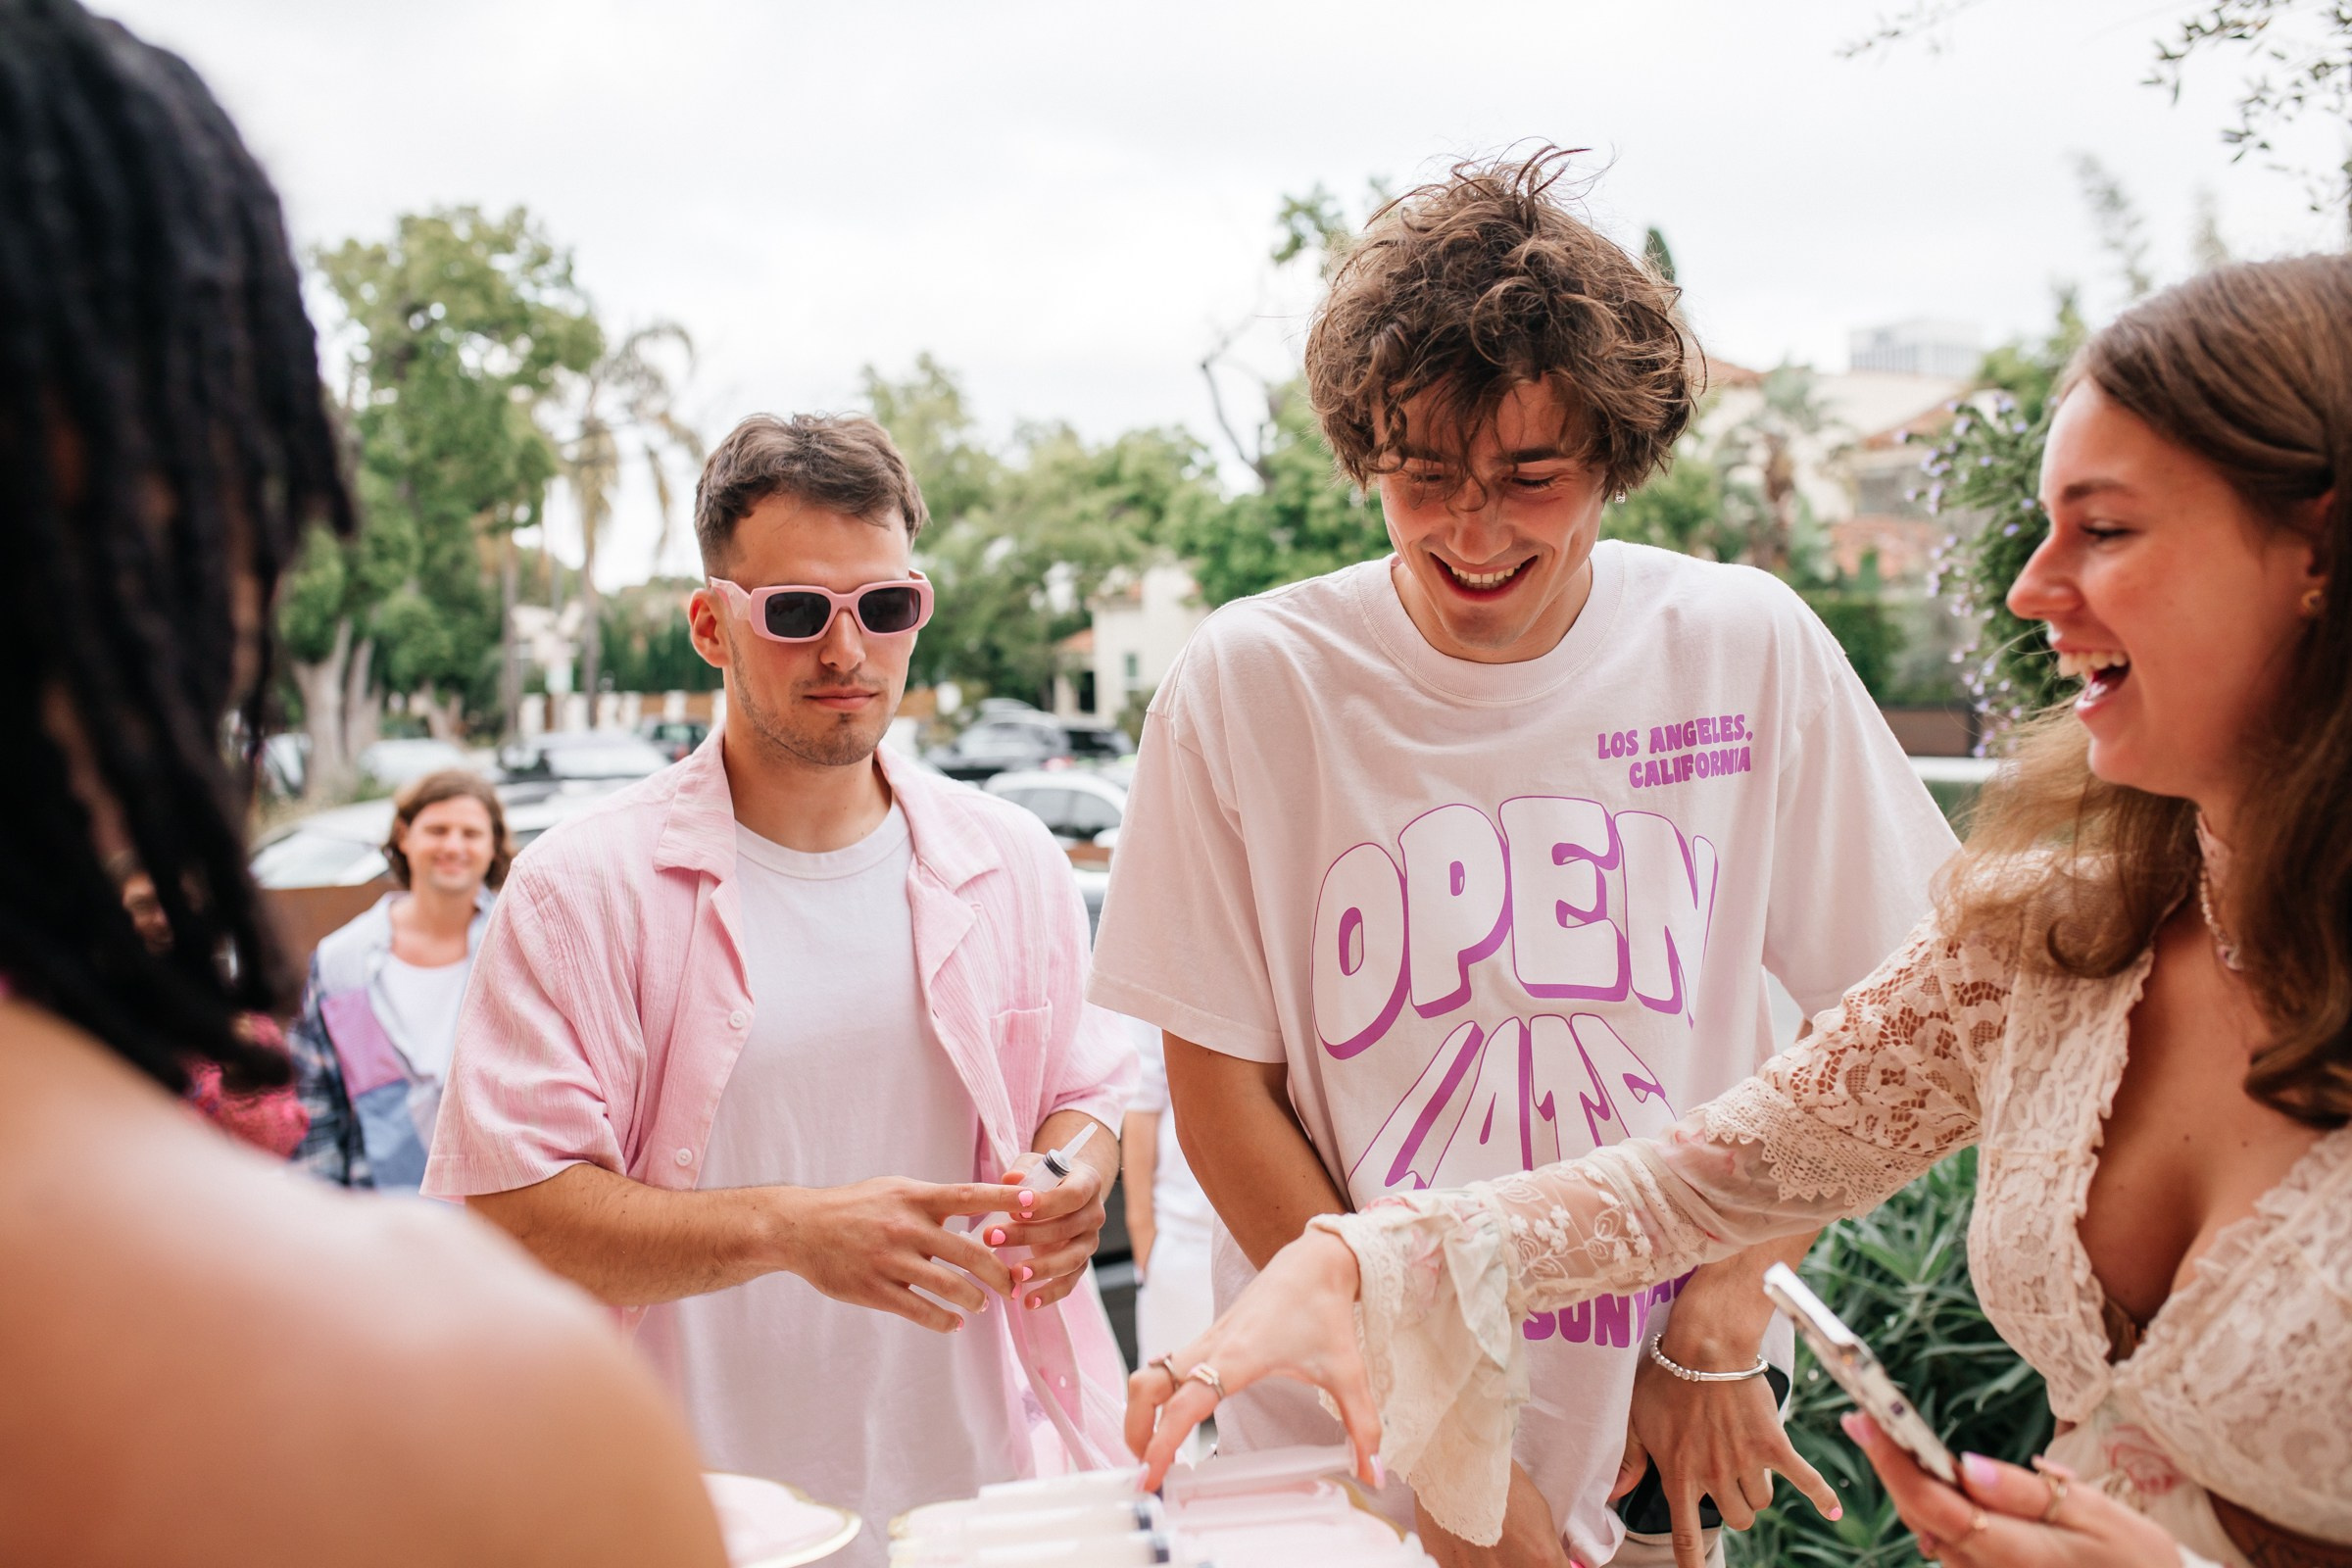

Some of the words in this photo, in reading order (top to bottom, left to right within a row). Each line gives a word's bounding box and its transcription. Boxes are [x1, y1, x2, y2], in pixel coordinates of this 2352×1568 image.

[1597, 729, 1640, 760] LOS
[1649, 713, 1753, 755] ANGELES,
[1629, 746, 1751, 789] CALIFORNIA
[1311, 796, 1718, 1059] OPEN
